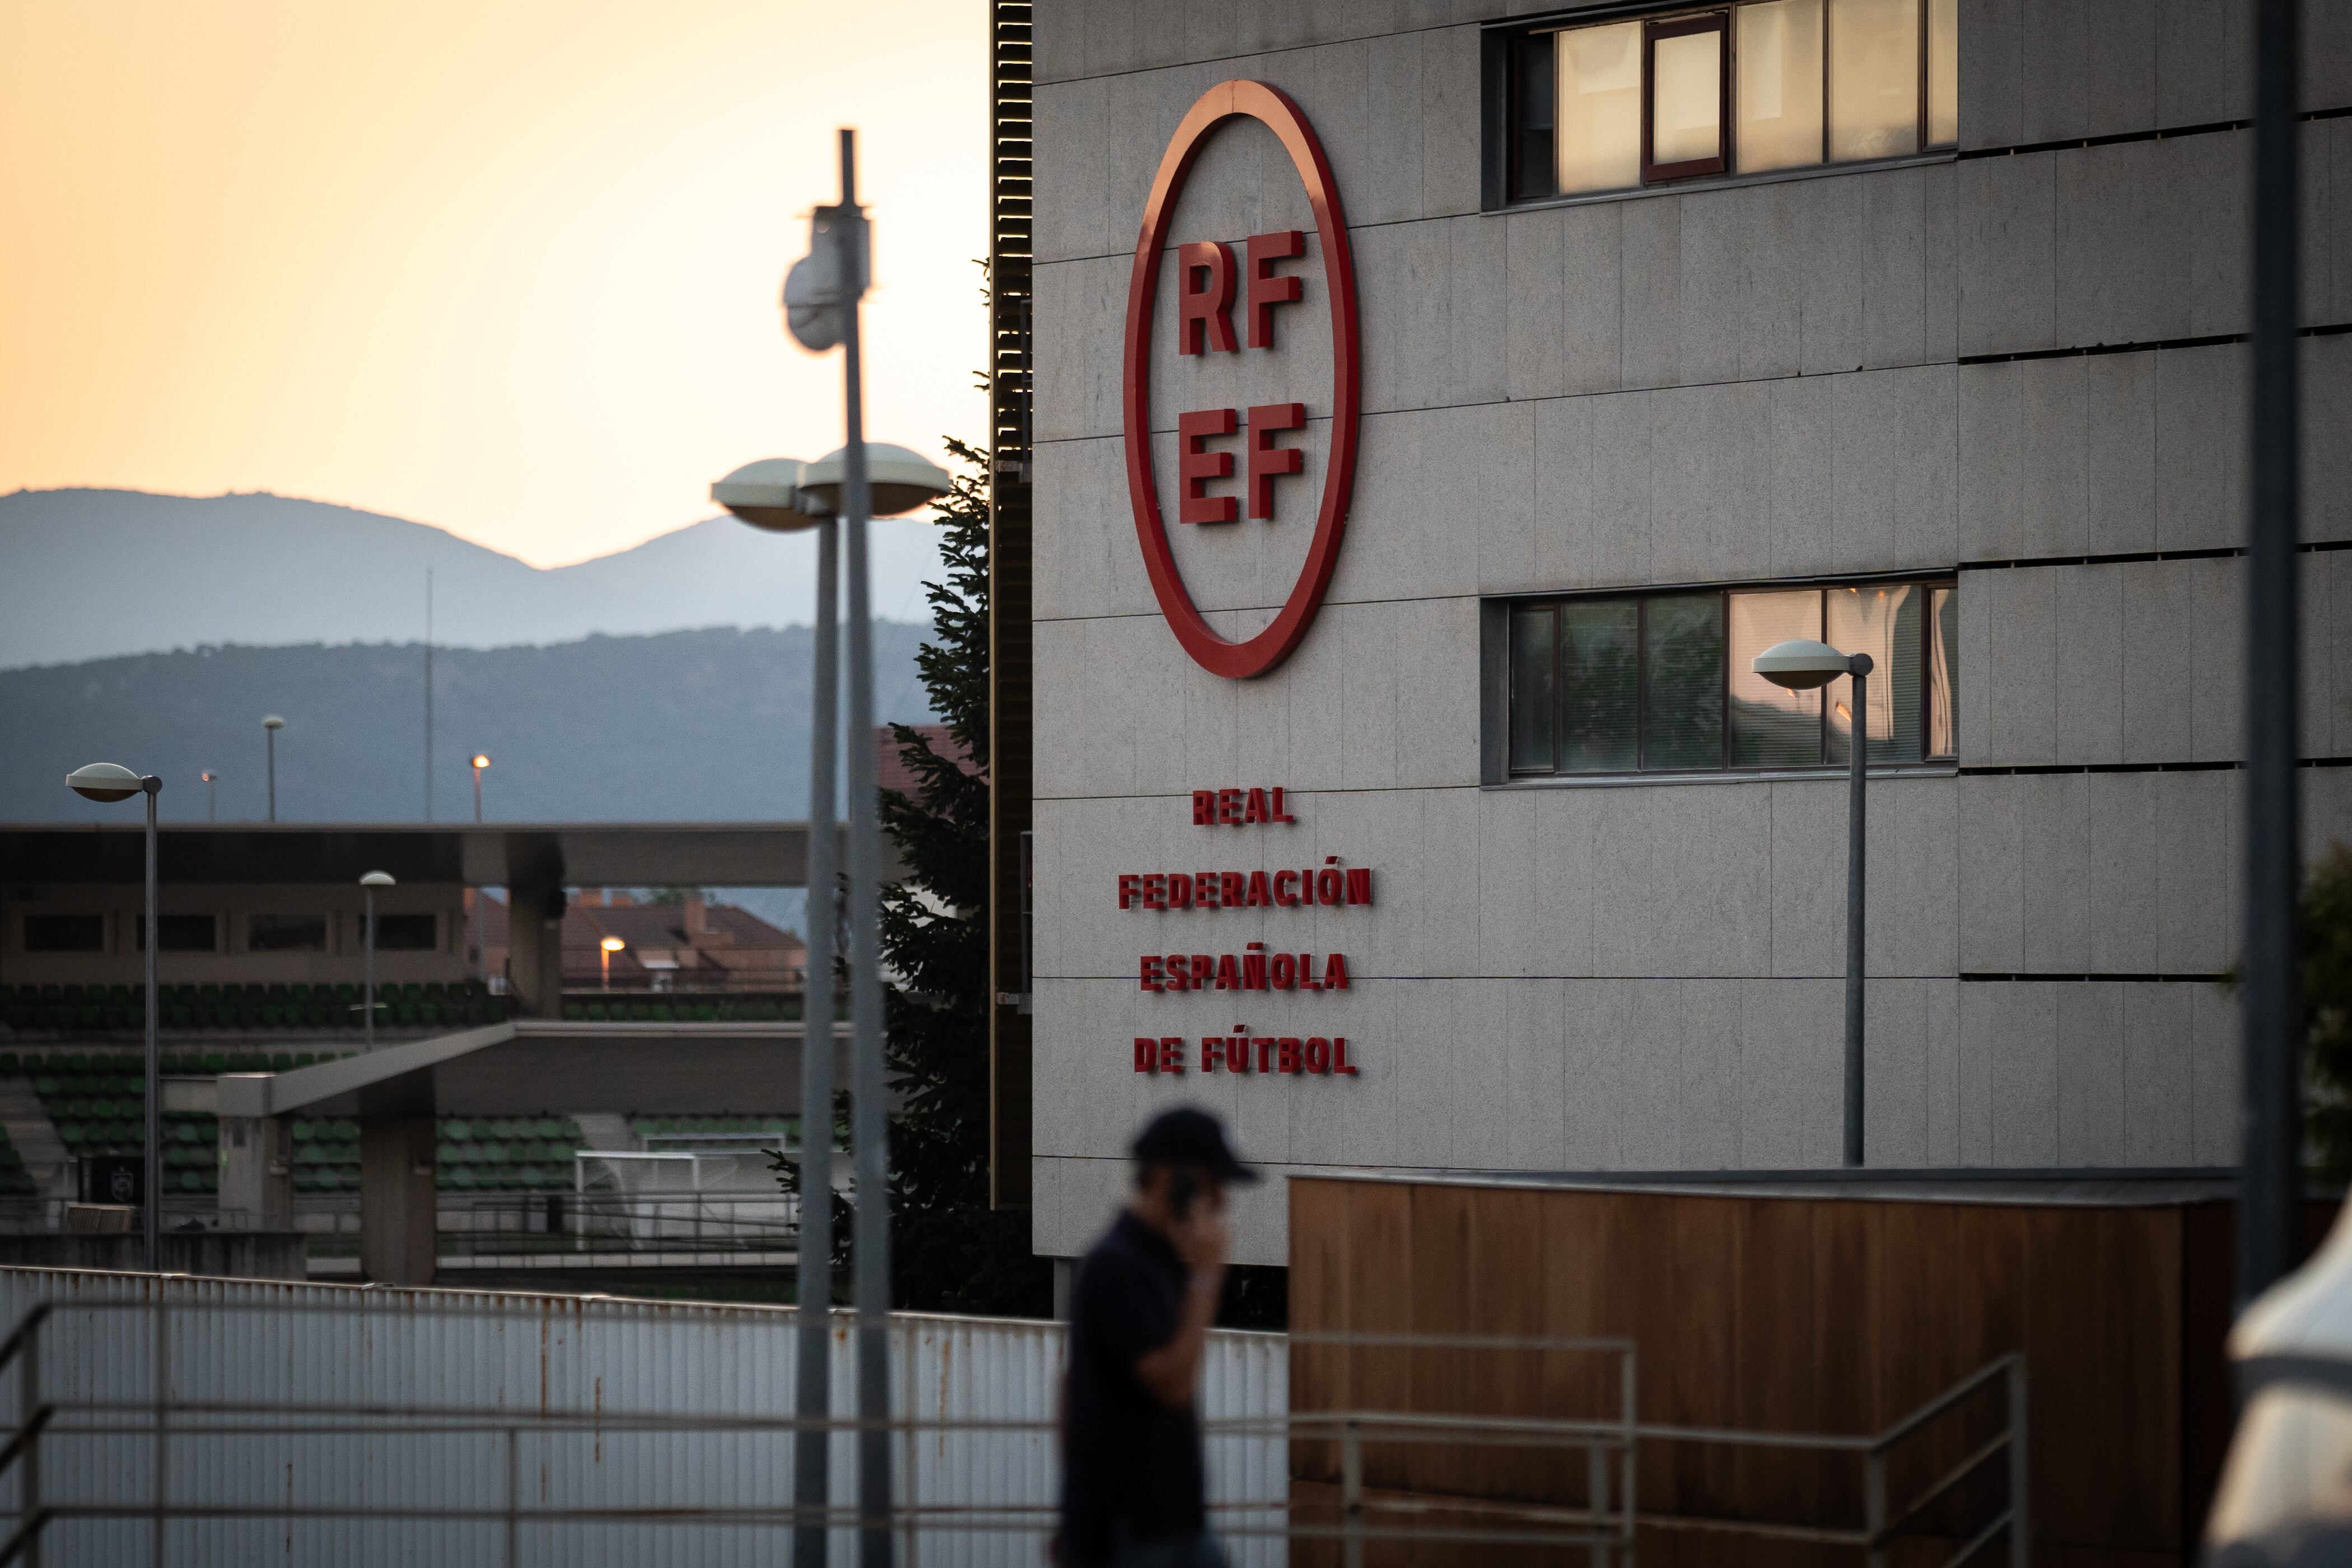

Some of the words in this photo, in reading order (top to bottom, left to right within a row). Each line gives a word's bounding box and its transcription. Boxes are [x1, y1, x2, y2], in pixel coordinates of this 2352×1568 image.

[1179, 231, 1303, 356] RF
[1179, 403, 1305, 524] EF
[1193, 787, 1294, 825] REAL
[1118, 856, 1371, 910] FEDERACIÓN
[1140, 942, 1348, 991] ESPAÑOLA
[1134, 1037, 1182, 1073] DE
[1201, 1024, 1356, 1074] FÚTBOL
